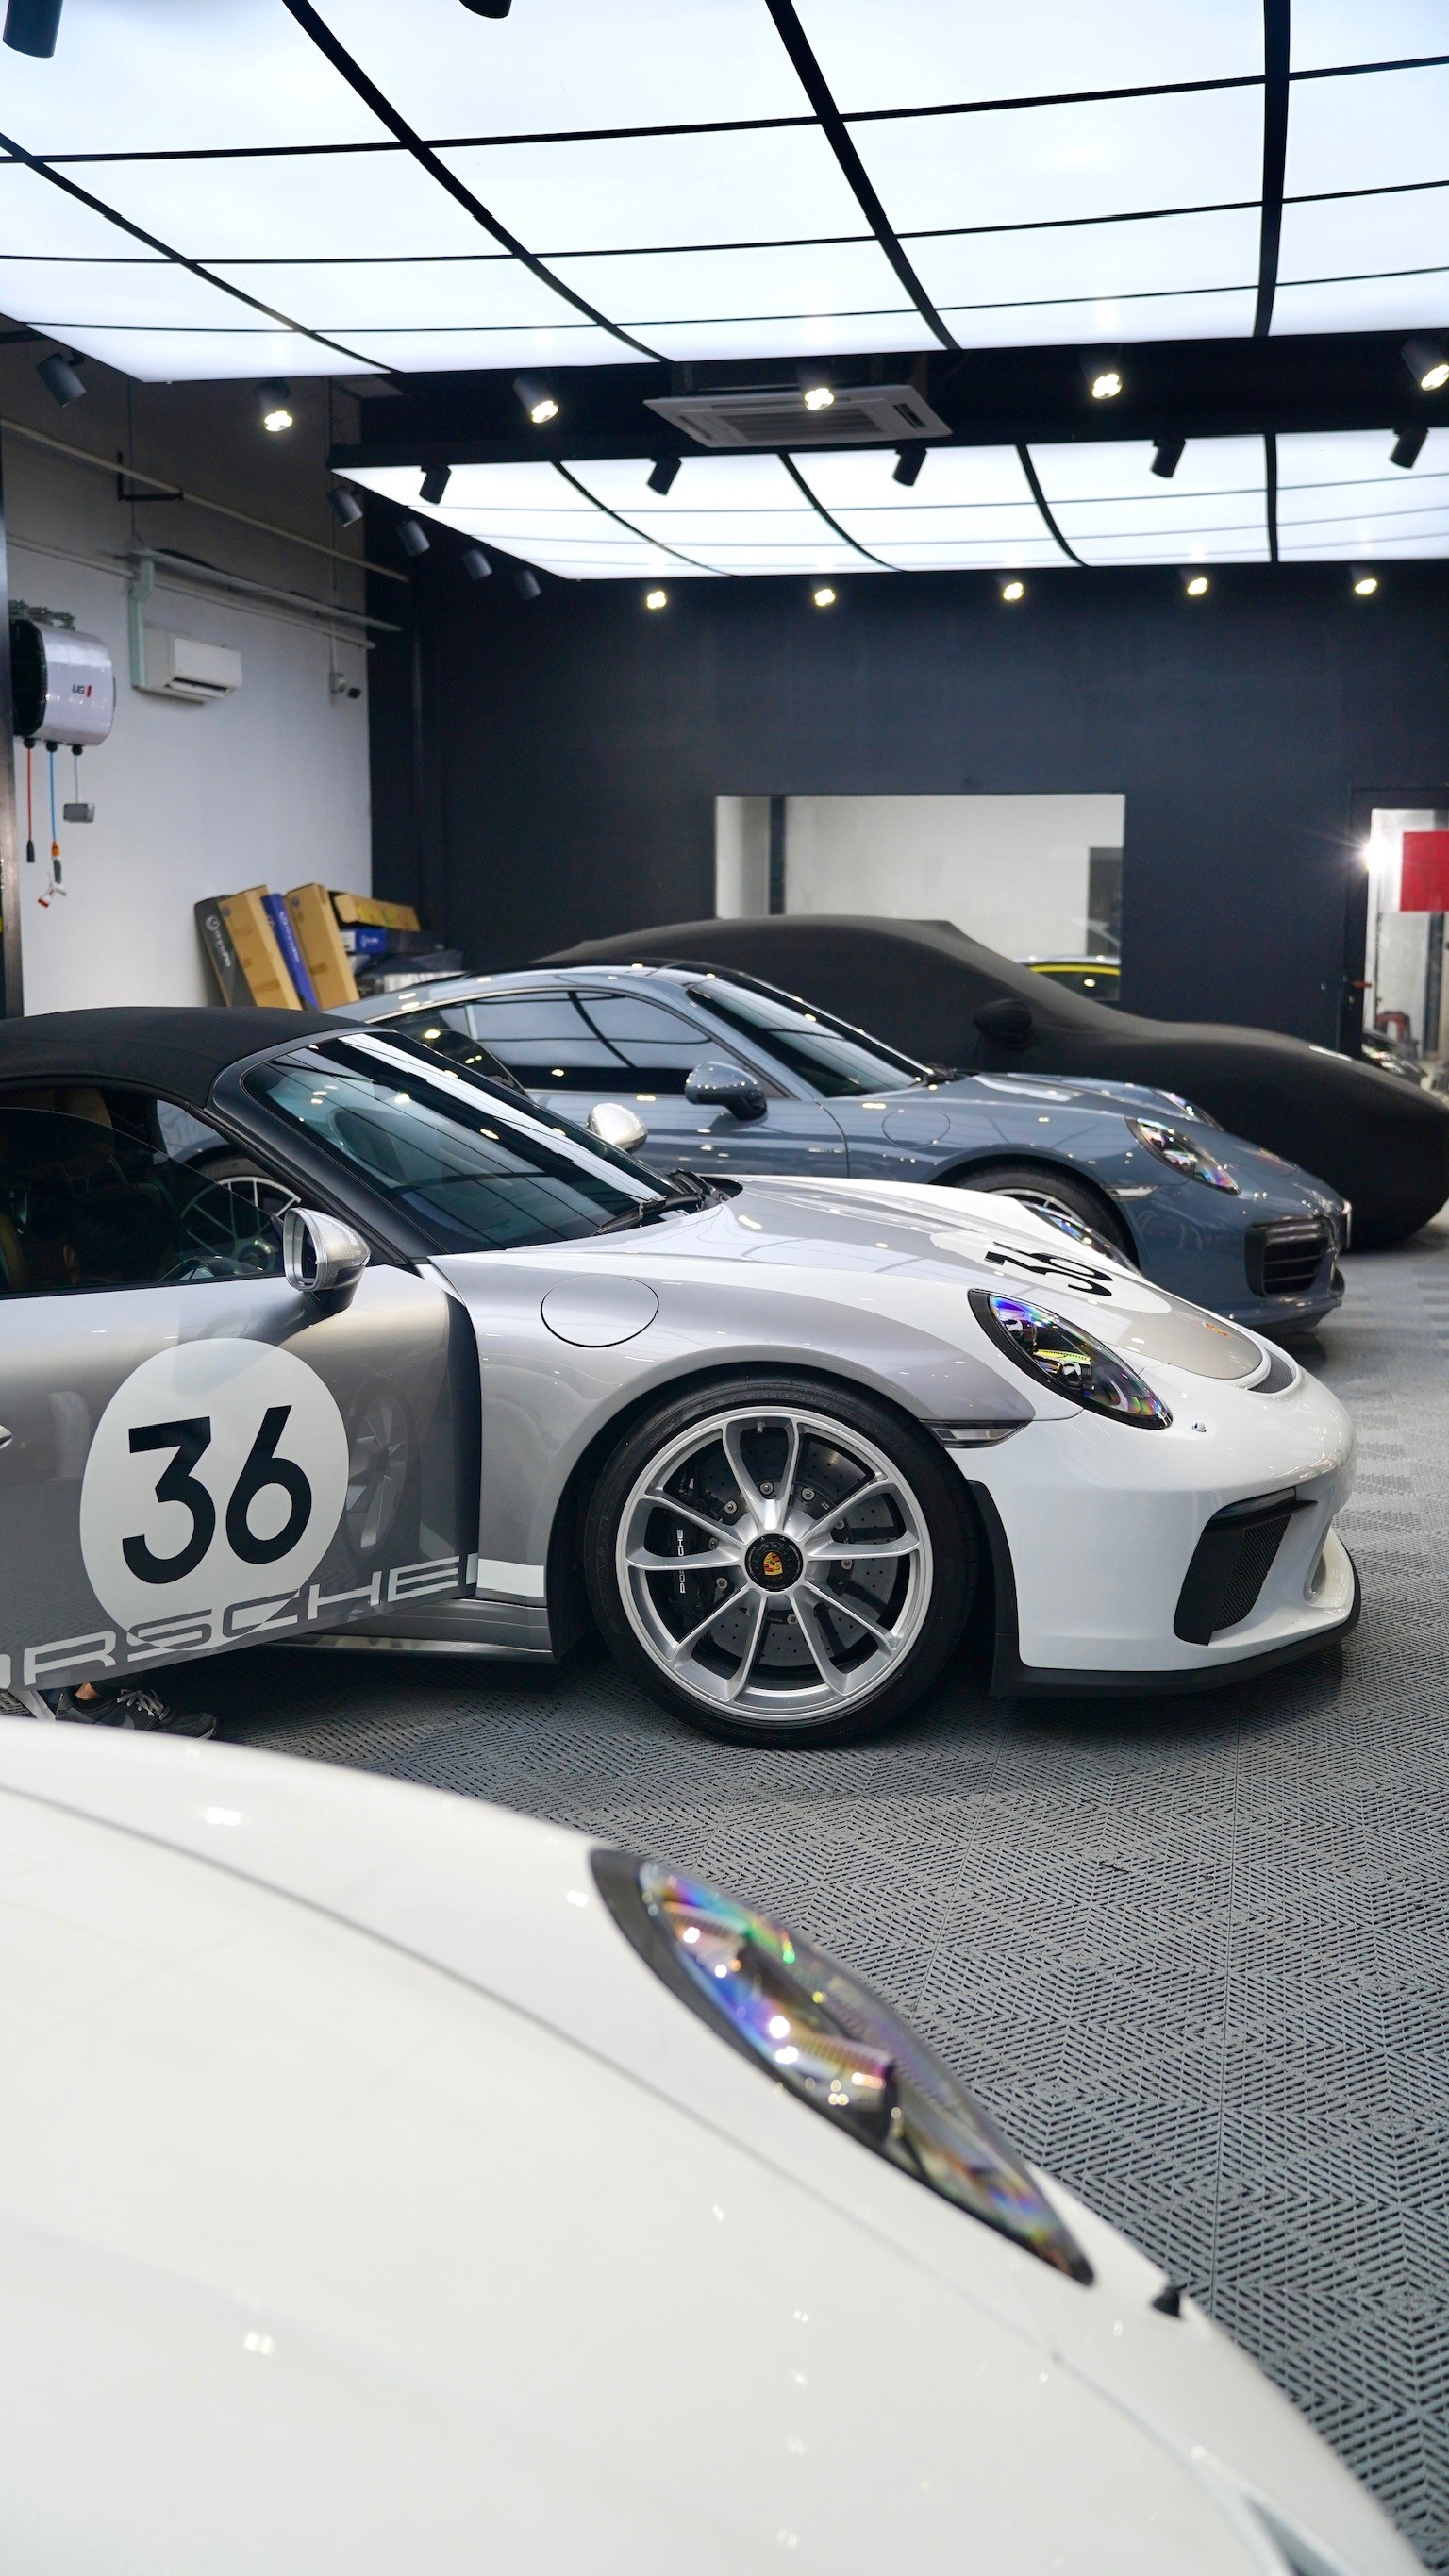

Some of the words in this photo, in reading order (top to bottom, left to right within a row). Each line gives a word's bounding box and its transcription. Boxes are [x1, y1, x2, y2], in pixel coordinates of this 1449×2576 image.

[984, 1241, 1114, 1296] 36
[122, 1404, 313, 1585] 36
[0, 1555, 460, 1690] RSCHE
